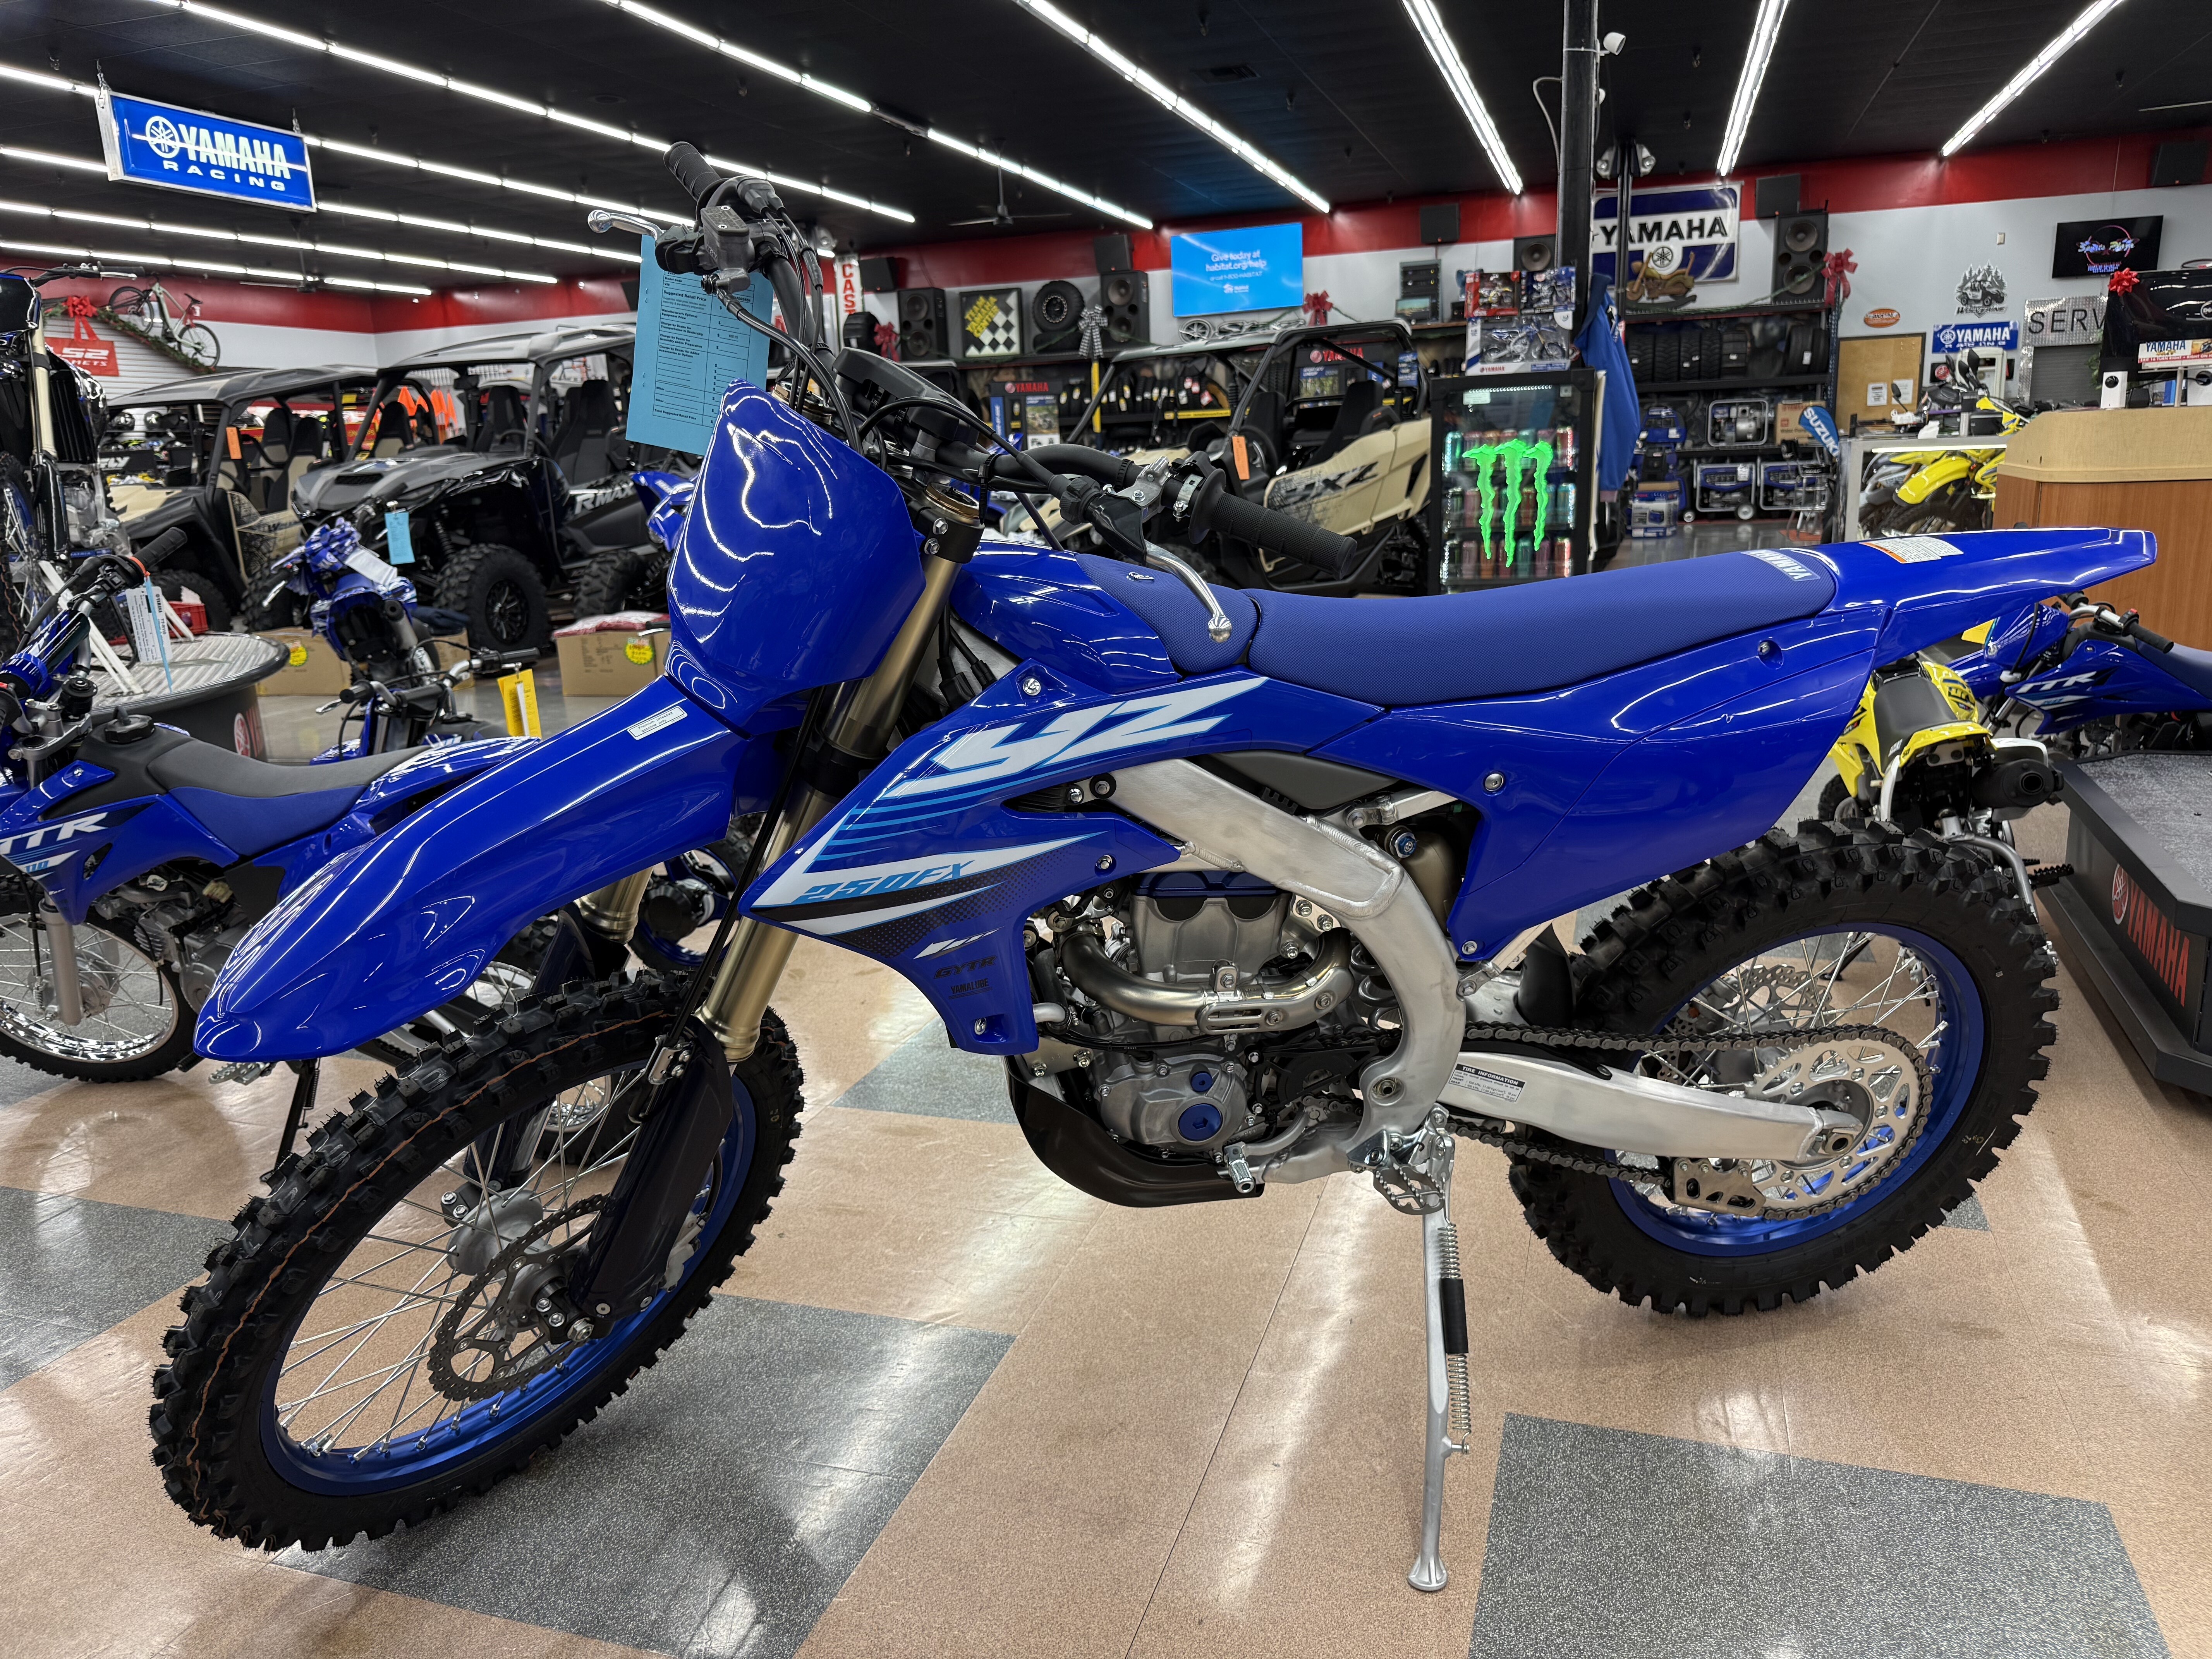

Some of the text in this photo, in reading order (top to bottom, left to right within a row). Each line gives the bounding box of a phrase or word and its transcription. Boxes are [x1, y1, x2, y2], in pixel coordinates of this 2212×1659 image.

[178, 124, 291, 179] YAMAHA
[163, 160, 285, 191] RACING
[1956, 326, 2010, 343] YAMAHA
[2146, 340, 2186, 352] YAMAHA
[57, 347, 109, 359] S2
[1016, 382, 1049, 393] YAMAHA
[1803, 407, 1839, 457] SUZUKI
[575, 485, 634, 515] RMAX
[1749, 549, 1812, 580] YAMAHA
[638, 720, 655, 729] Premium
[906, 677, 1269, 790] YZ
[791, 860, 975, 904] 250FX
[2127, 878, 2190, 1008] YAMAHA
[934, 955, 998, 979] GYTR
[950, 978, 989, 994] YAMALUBE
[1477, 1071, 1518, 1085] INFORMATION
